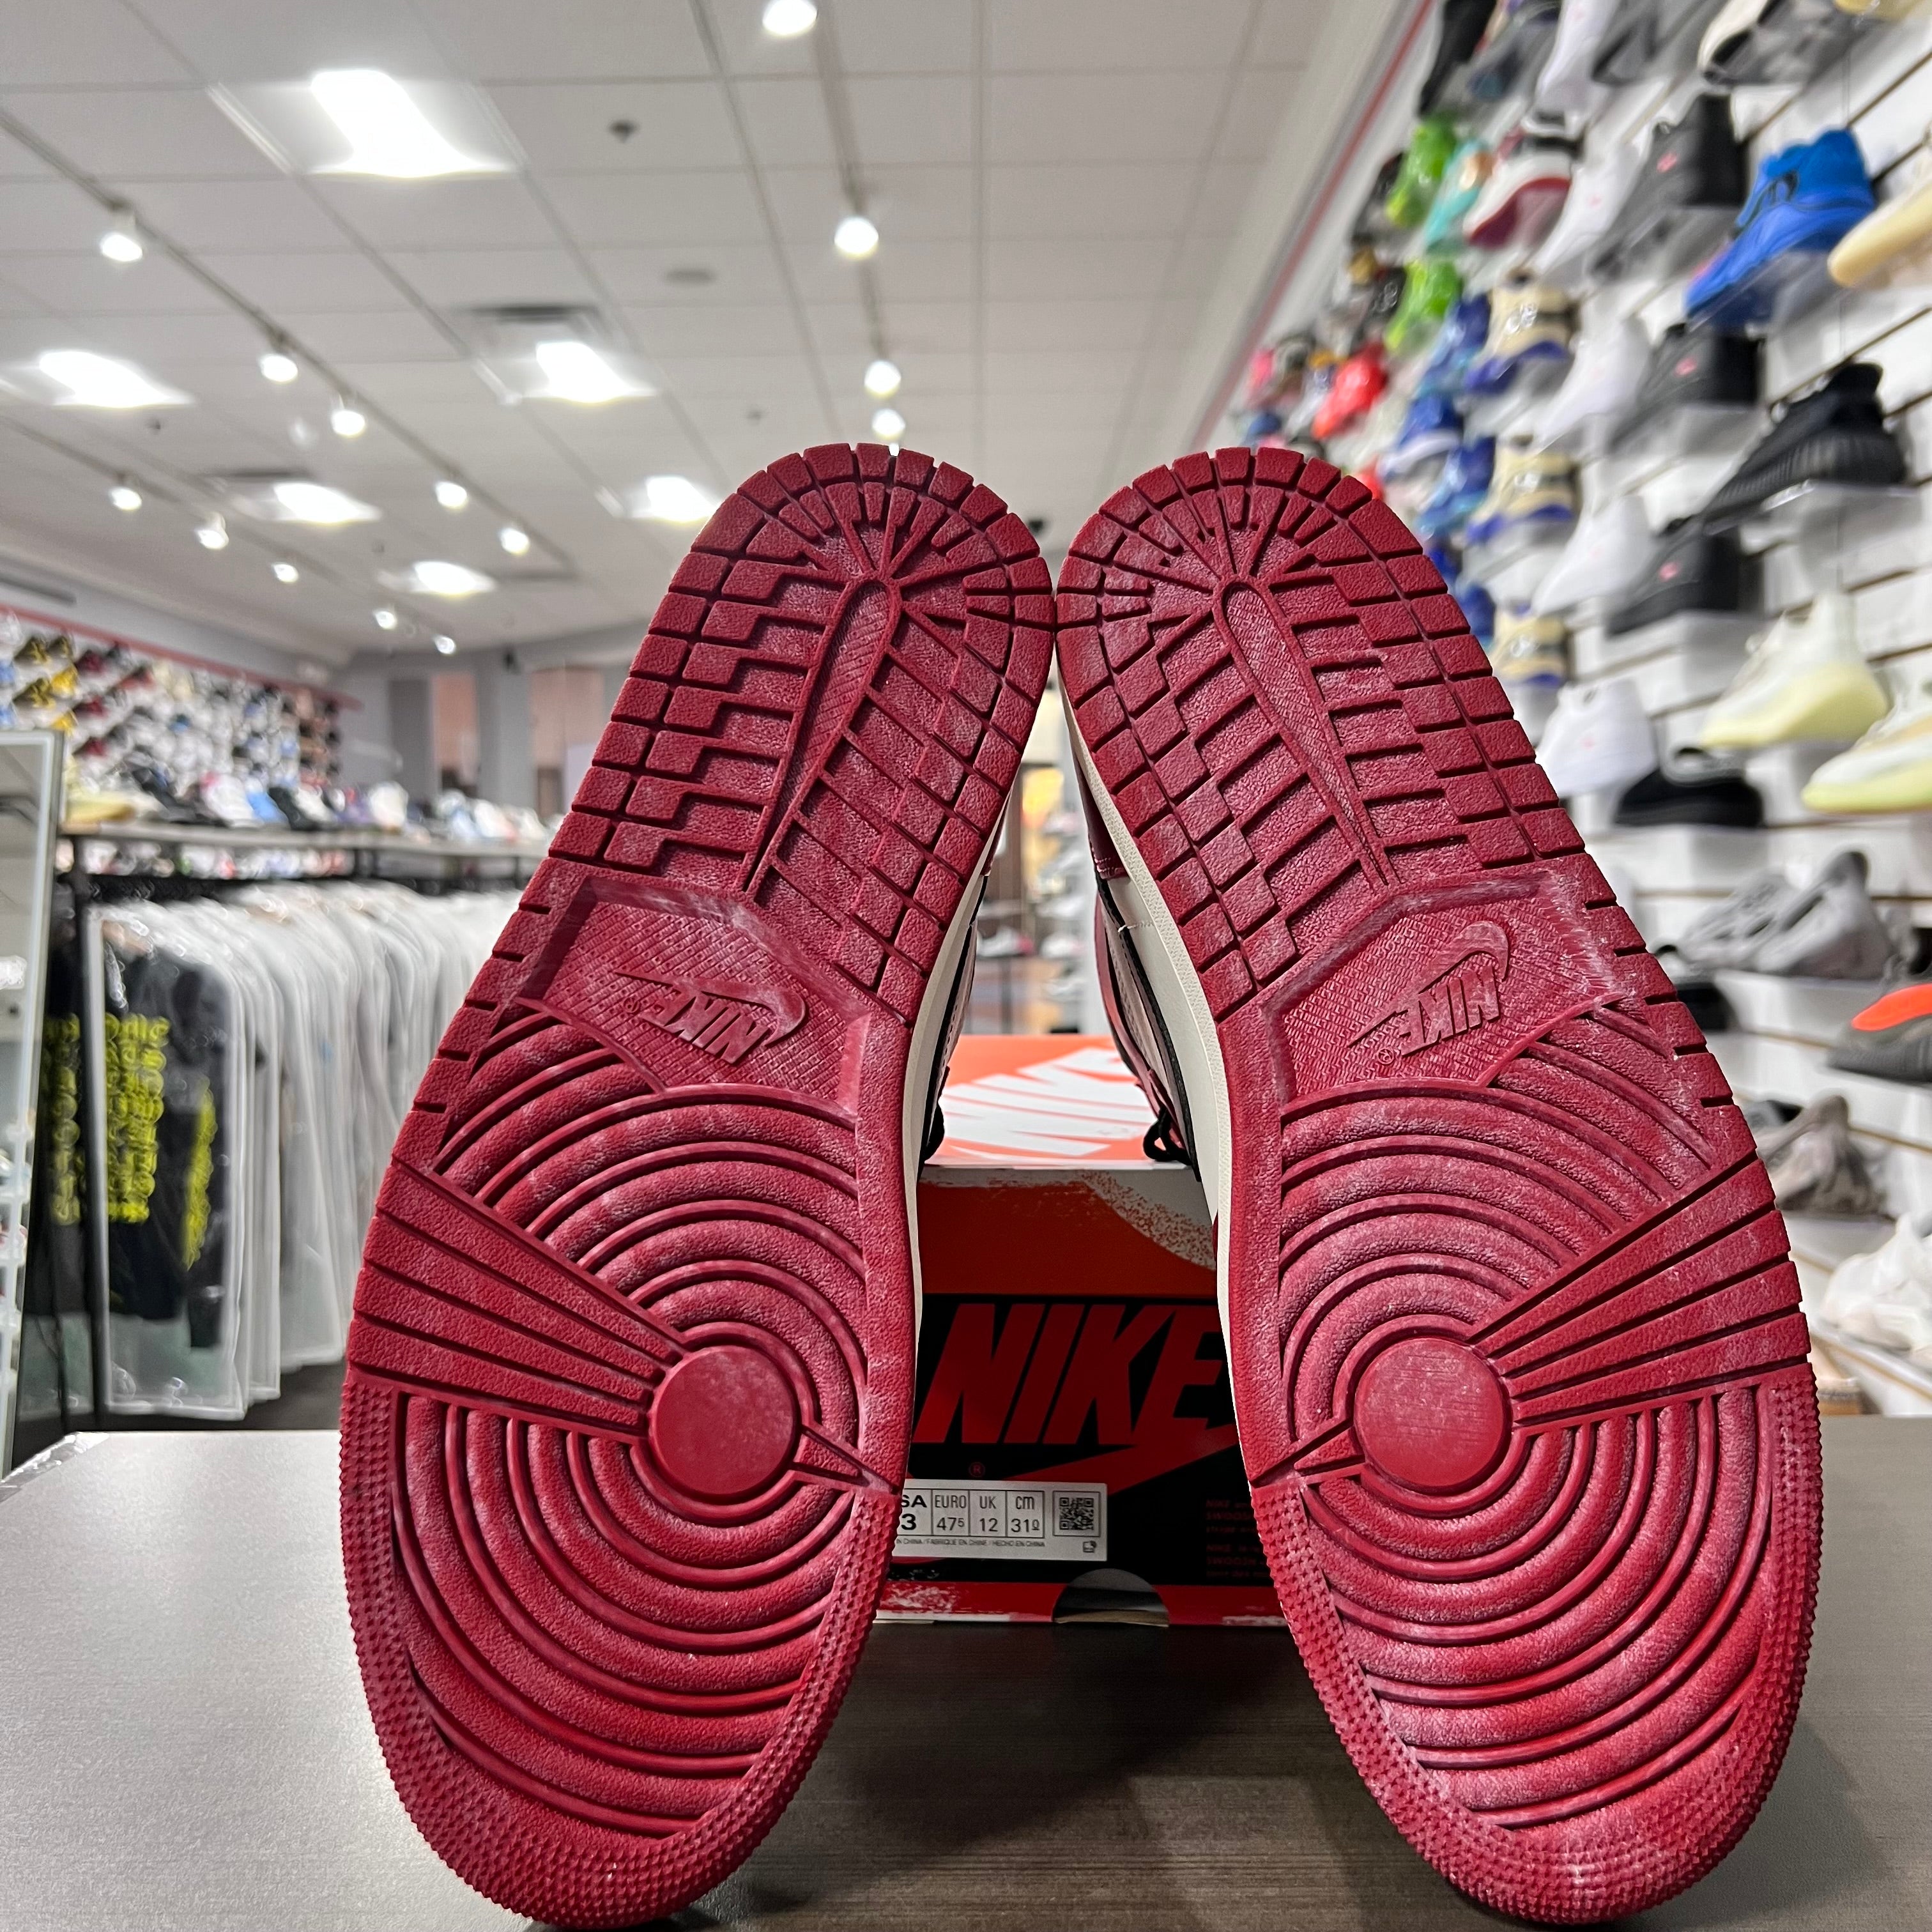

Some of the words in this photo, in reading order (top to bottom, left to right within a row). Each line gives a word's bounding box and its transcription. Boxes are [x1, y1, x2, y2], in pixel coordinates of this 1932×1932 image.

[639, 989, 770, 1064] NIKE
[1399, 965, 1501, 1057] NIKE
[912, 1303, 1223, 1445] NIKE
[901, 1494, 928, 1508] SA
[935, 1494, 967, 1508] EURO
[979, 1496, 997, 1509] UK
[901, 1513, 917, 1530] 3
[979, 1517, 998, 1532] 12
